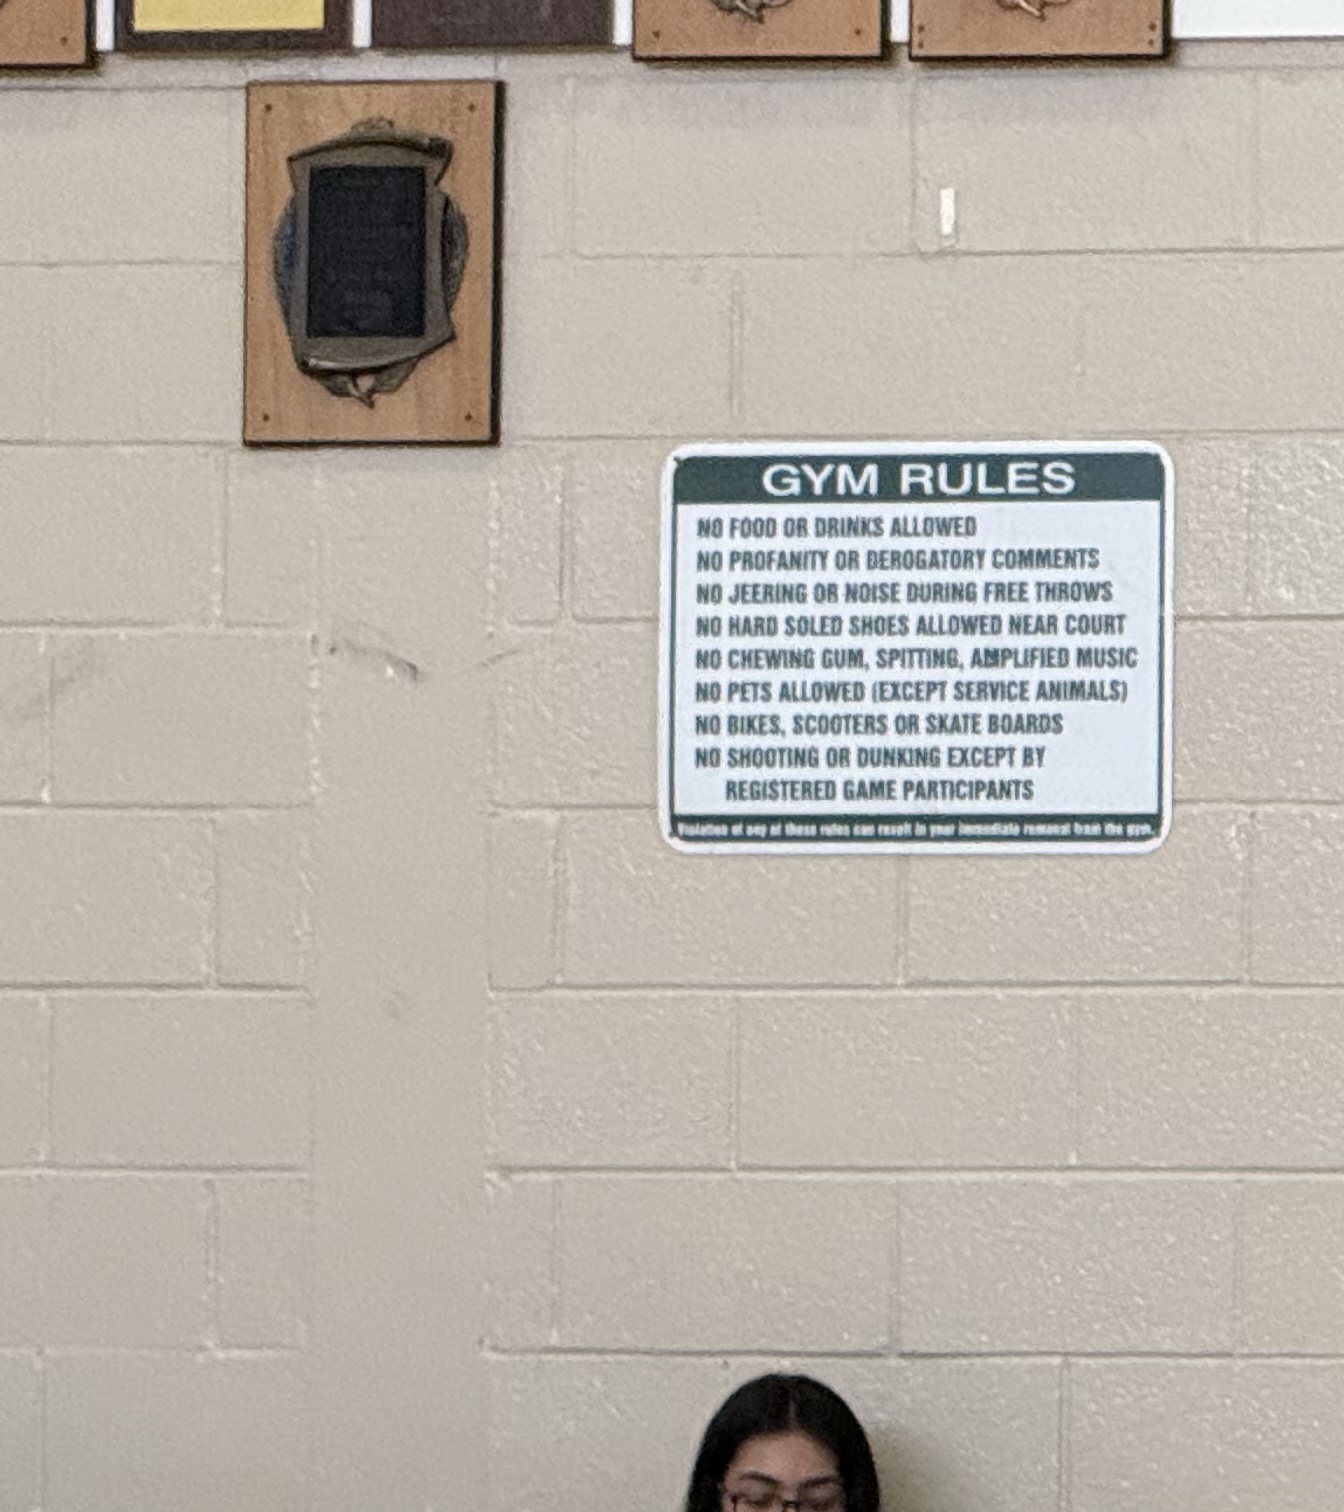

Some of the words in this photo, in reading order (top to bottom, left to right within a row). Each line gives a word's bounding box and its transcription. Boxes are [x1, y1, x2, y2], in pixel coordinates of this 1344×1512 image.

[762, 463, 878, 496] GYM
[900, 462, 1076, 495] RULES
[697, 517, 724, 539] NO
[729, 517, 777, 539] FOOD
[783, 517, 808, 538] OR
[814, 516, 885, 538] DRINKS
[889, 516, 977, 538] ALLOWED
[696, 550, 723, 572] NO
[729, 550, 829, 571] PROFANITY
[834, 549, 860, 571] OR
[866, 549, 986, 571] DEROGATORY
[991, 548, 1100, 570] COMMENTS
[696, 583, 723, 604] NO
[728, 583, 808, 604] JEERING
[813, 582, 839, 604] OR
[844, 582, 900, 604] NOISE
[906, 582, 978, 603] DURING
[983, 581, 1028, 603] FREE
[1035, 581, 1113, 602] THROWS
[696, 615, 722, 637] NO
[728, 616, 779, 637] HARD
[784, 615, 843, 637] SOLED
[848, 615, 910, 637] SHOES
[916, 614, 1003, 636] ALLOWED
[1008, 614, 1058, 636] NEAR
[1065, 613, 1127, 635] COURT
[695, 649, 722, 670] NO
[727, 648, 815, 670] CHEWING
[821, 648, 870, 672] GUM,
[875, 647, 965, 672] SPITTING,
[970, 647, 1070, 669] AMPLIFIED
[1076, 647, 1138, 668] MUSIC
[695, 681, 722, 703] NO
[727, 681, 772, 703] PETS
[778, 681, 866, 703] ALLOWED
[871, 680, 947, 703] (EXCEPT
[953, 680, 1030, 702] SERVICE
[1035, 680, 1128, 703] ANIMALS)
[695, 714, 721, 736] NO
[727, 714, 786, 738] BIKES,
[792, 714, 888, 735] SCOOTERS
[894, 713, 920, 735] OR
[925, 713, 981, 735] SKATE
[987, 713, 1064, 735] BOARDS
[694, 747, 721, 768] NO
[727, 747, 820, 769] SHOOTING
[825, 746, 851, 768] OR
[857, 747, 941, 768] DUNKING
[947, 746, 1016, 768] EXCEPT
[1022, 746, 1046, 768] BY
[725, 779, 837, 801] REGISTERED
[842, 779, 897, 801] GAME
[902, 779, 1034, 801] PARTICIPANTS
